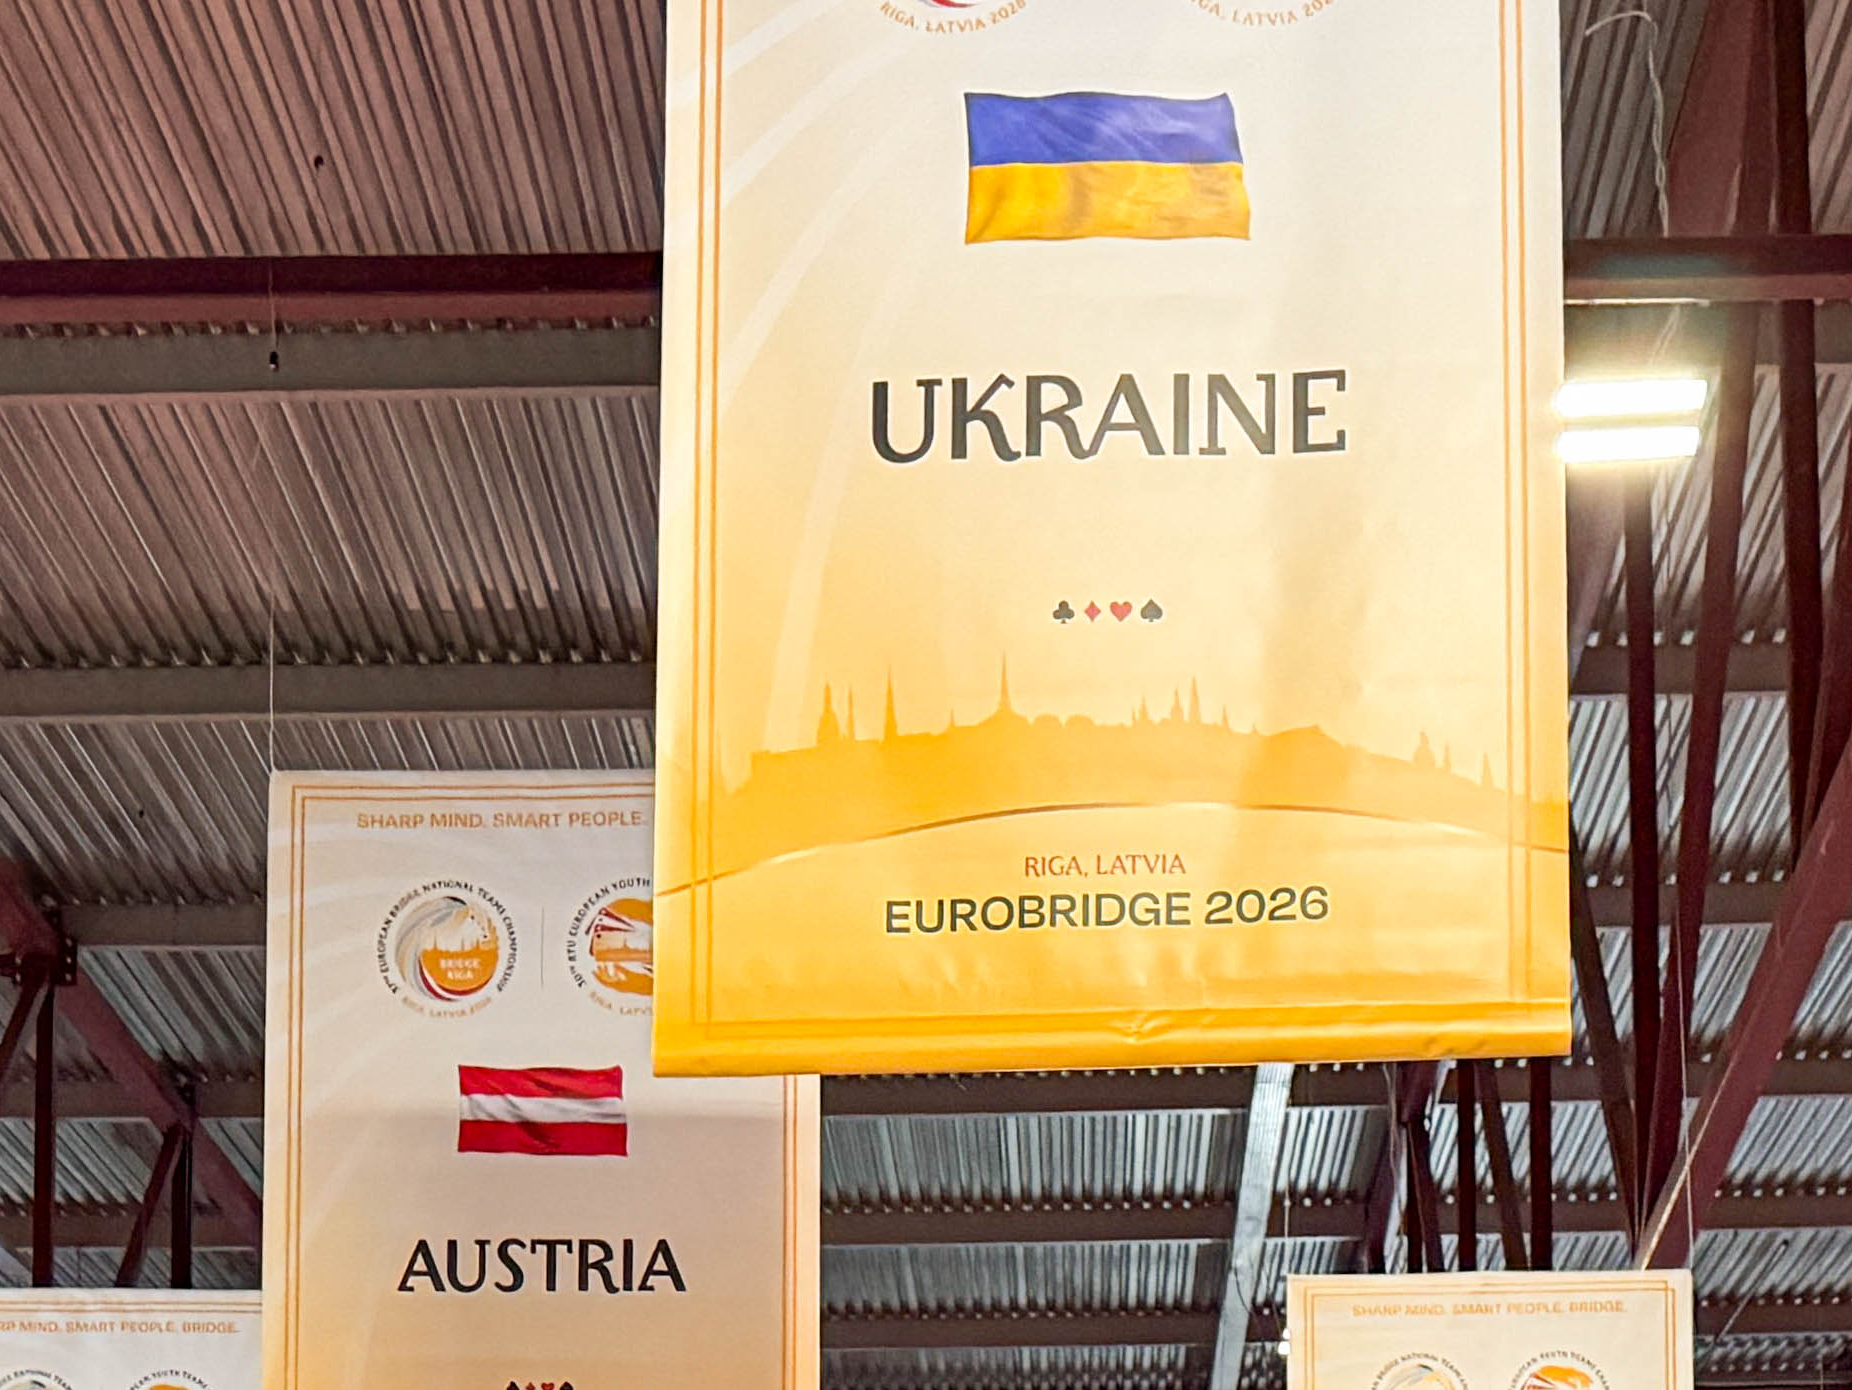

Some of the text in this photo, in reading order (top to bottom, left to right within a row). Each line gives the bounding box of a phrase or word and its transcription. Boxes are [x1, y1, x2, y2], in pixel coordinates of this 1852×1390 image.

[926, 18, 987, 35] LATVIA
[1232, 10, 1298, 26] LATVIA
[871, 369, 1347, 465] UKRAINE
[357, 812, 425, 829] SHARP
[492, 811, 562, 828] SMART
[1024, 853, 1187, 879] RIGA, LATVIA
[611, 877, 651, 891] YOUTH
[885, 885, 1330, 935] EUROBRIDGE 2026
[397, 1237, 687, 1294] AUSTRIA
[1351, 1303, 1402, 1317] SHARP
[1451, 1302, 1502, 1316] SMART
[66, 1320, 116, 1333] SMART
